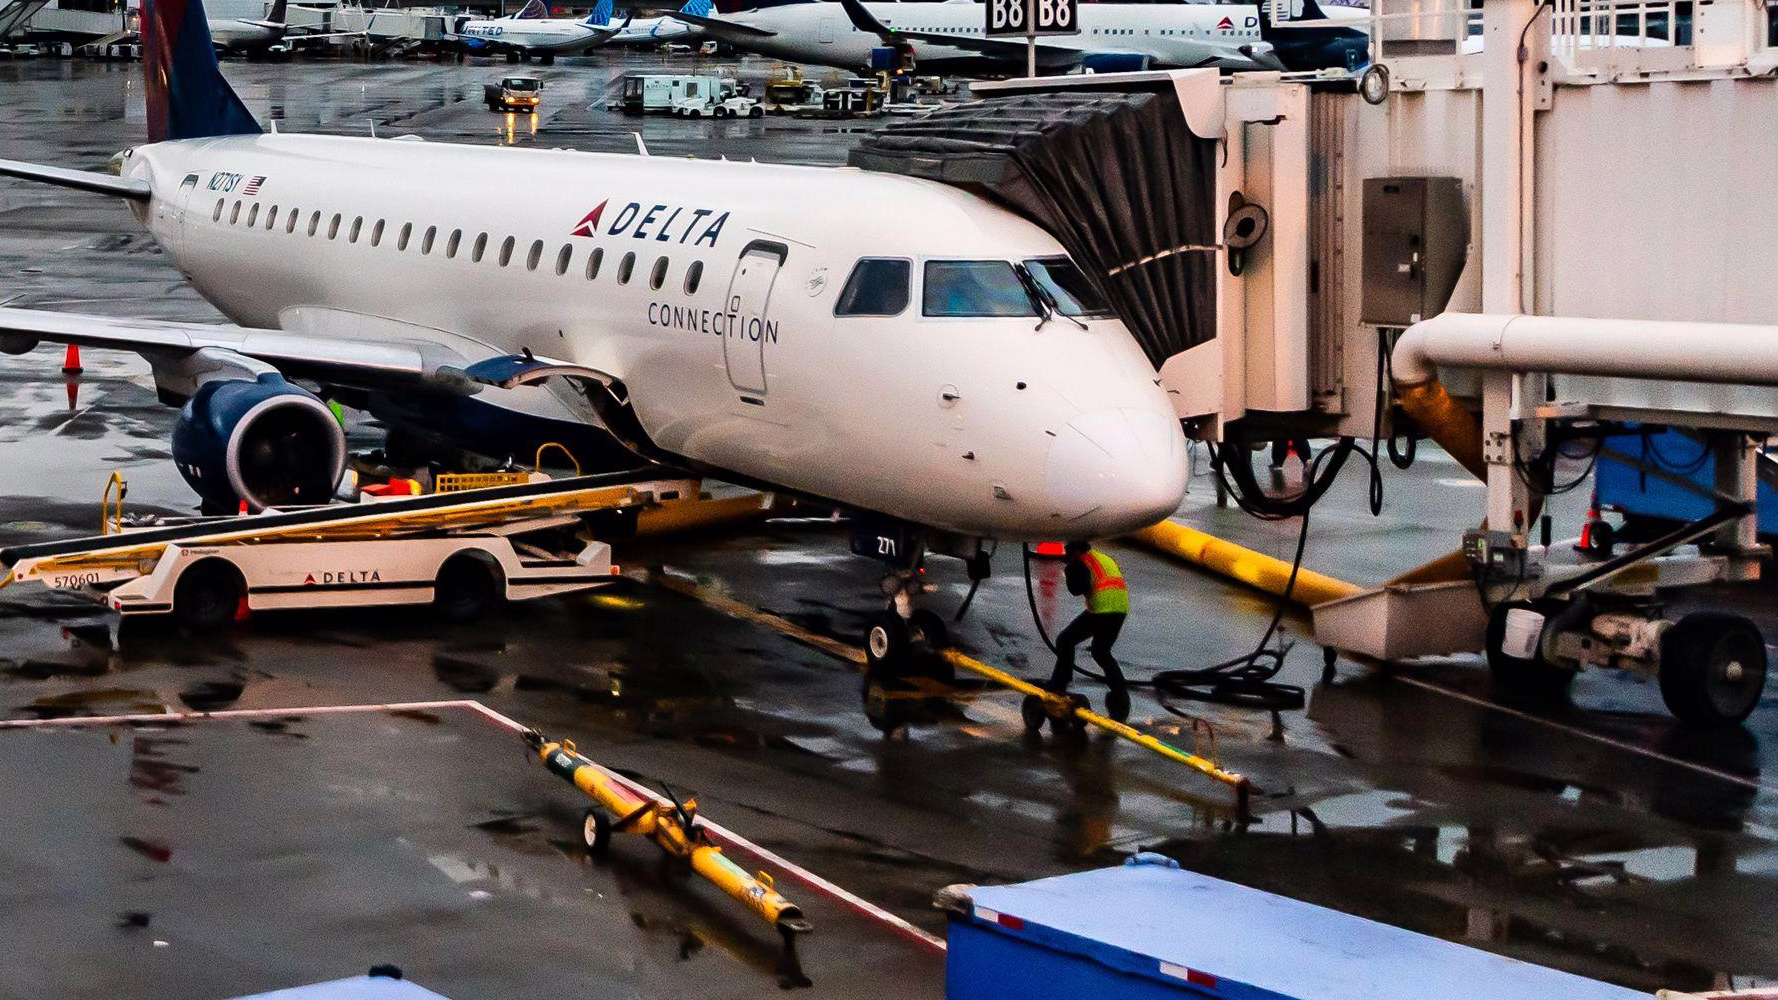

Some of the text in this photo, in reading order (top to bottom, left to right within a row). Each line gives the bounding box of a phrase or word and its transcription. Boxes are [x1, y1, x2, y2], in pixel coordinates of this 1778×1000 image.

[607, 202, 731, 248] DELTA
[648, 302, 779, 344] CONNECTION
[877, 536, 896, 556] 271
[323, 571, 381, 583] DELTA
